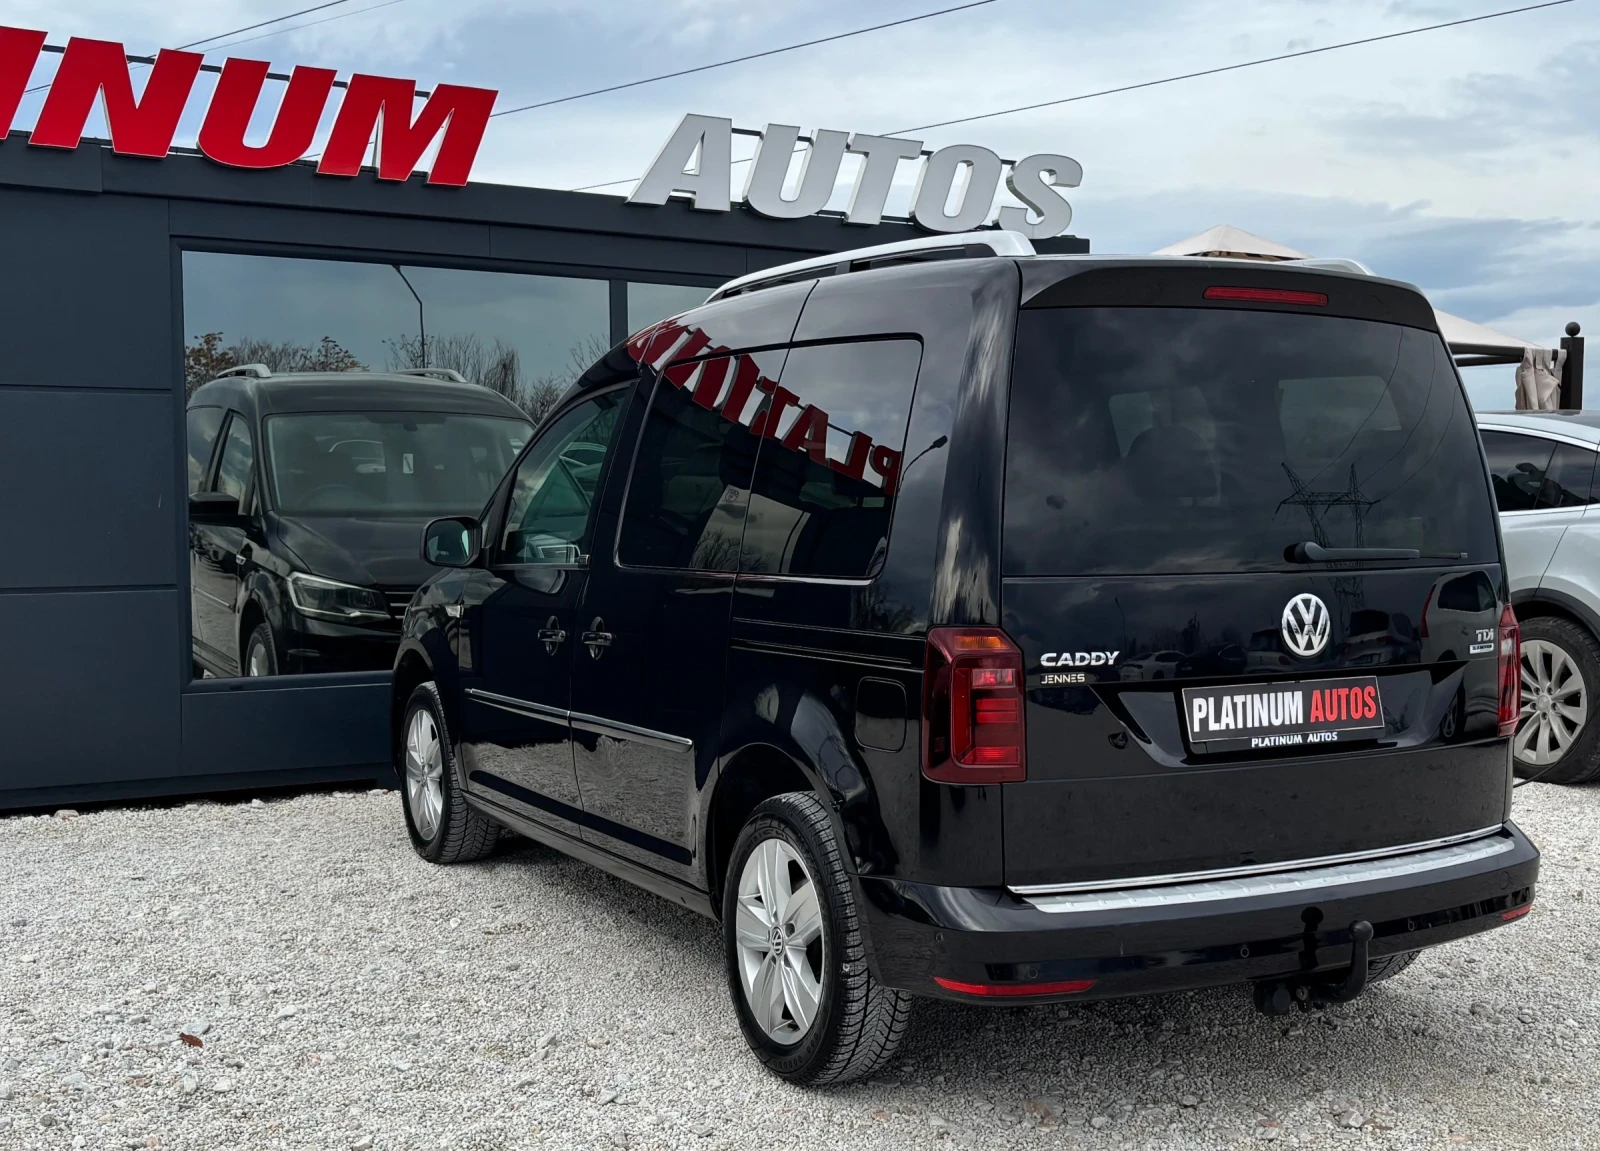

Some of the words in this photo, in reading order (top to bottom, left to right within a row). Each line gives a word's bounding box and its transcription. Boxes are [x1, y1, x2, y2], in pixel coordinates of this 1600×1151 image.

[624, 113, 1083, 240] AUTOS
[1040, 650, 1120, 667] CADDY
[1041, 673, 1086, 685] JENNES
[1192, 690, 1304, 733] PLATINUM
[1310, 685, 1377, 723] AUTOS
[1251, 734, 1303, 748] PLATINUM
[1307, 731, 1338, 744] AUTOS
